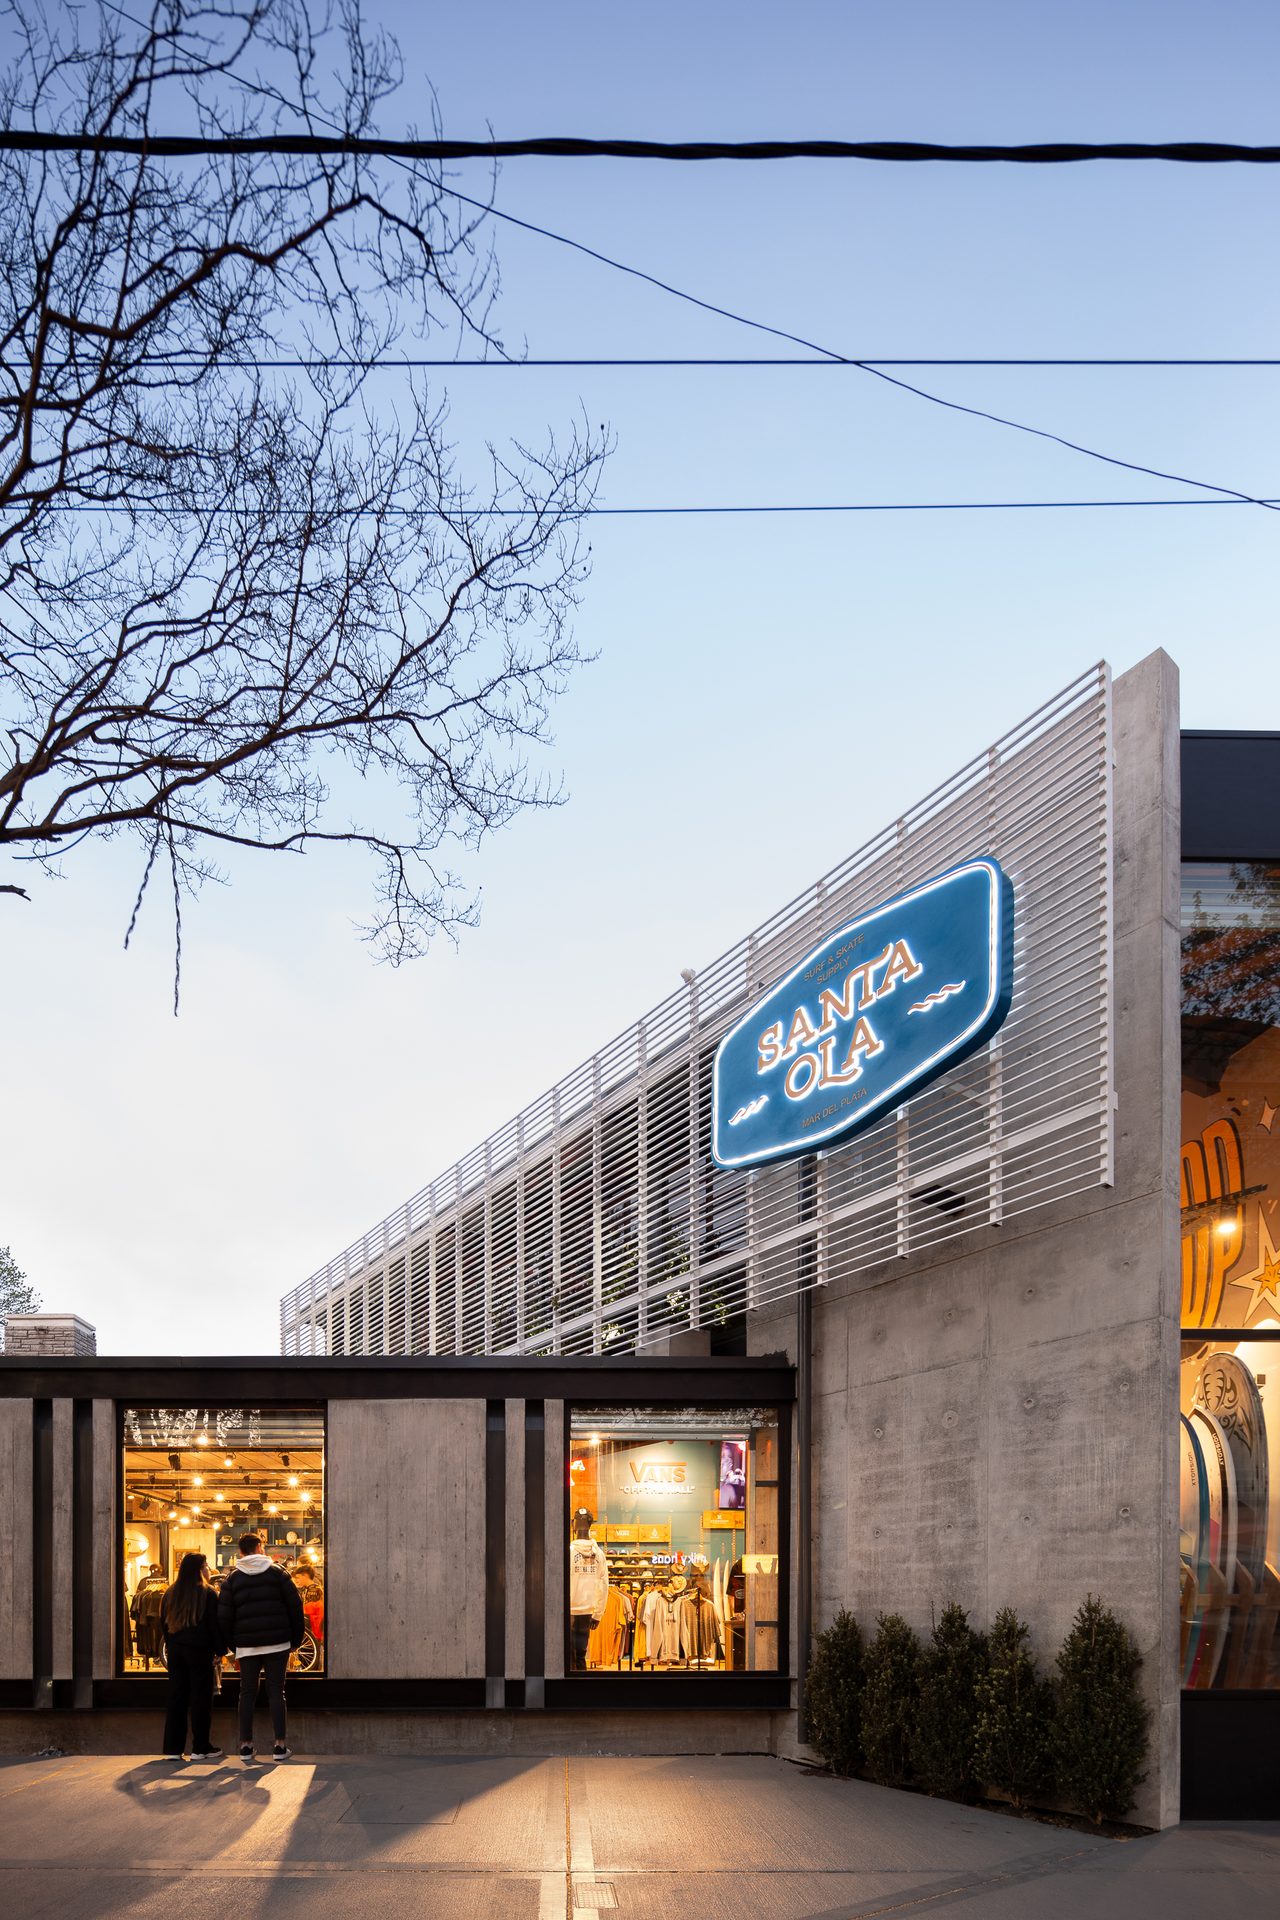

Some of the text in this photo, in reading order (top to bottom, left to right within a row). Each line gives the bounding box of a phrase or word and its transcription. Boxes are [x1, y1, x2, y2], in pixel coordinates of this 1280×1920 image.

[804, 932, 865, 981] SURF & SKATE
[817, 955, 850, 984] SUPPLY
[757, 938, 923, 1075] SANTA
[784, 1016, 884, 1101] OLA
[802, 1087, 868, 1128] MAR DEL PLATA
[629, 1461, 688, 1483] VANS
